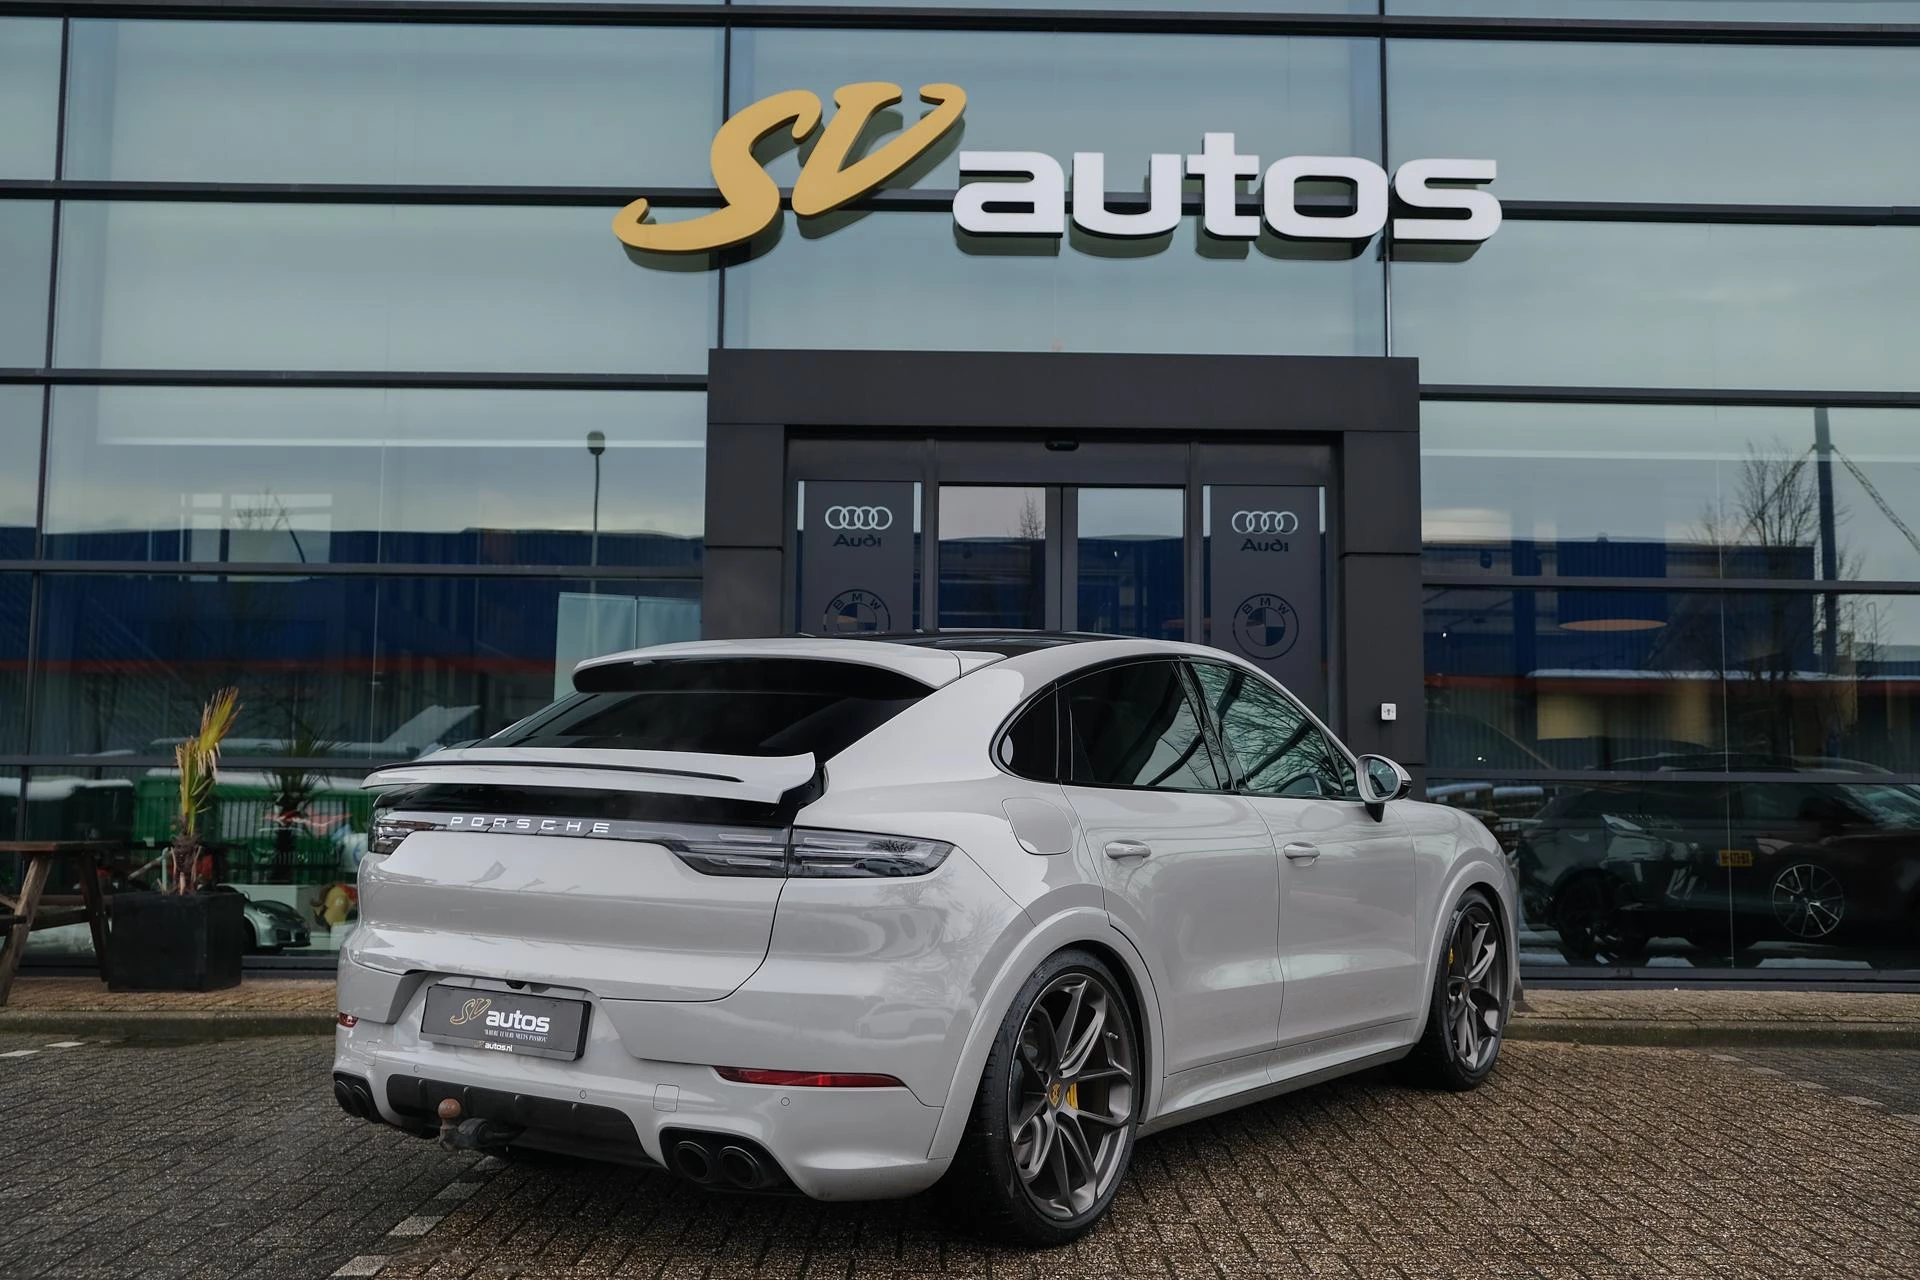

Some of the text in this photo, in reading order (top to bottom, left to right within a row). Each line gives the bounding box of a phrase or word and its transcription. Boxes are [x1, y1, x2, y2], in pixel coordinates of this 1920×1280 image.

[611, 81, 1503, 252] SV autos
[832, 534, 881, 548] Audi
[1240, 538, 1289, 552] Audi
[833, 593, 881, 611] BMW
[1242, 597, 1290, 615] BMW
[450, 816, 610, 833] PORSCHE
[485, 1010, 550, 1033] autos
[484, 1042, 513, 1052] autos.nl
